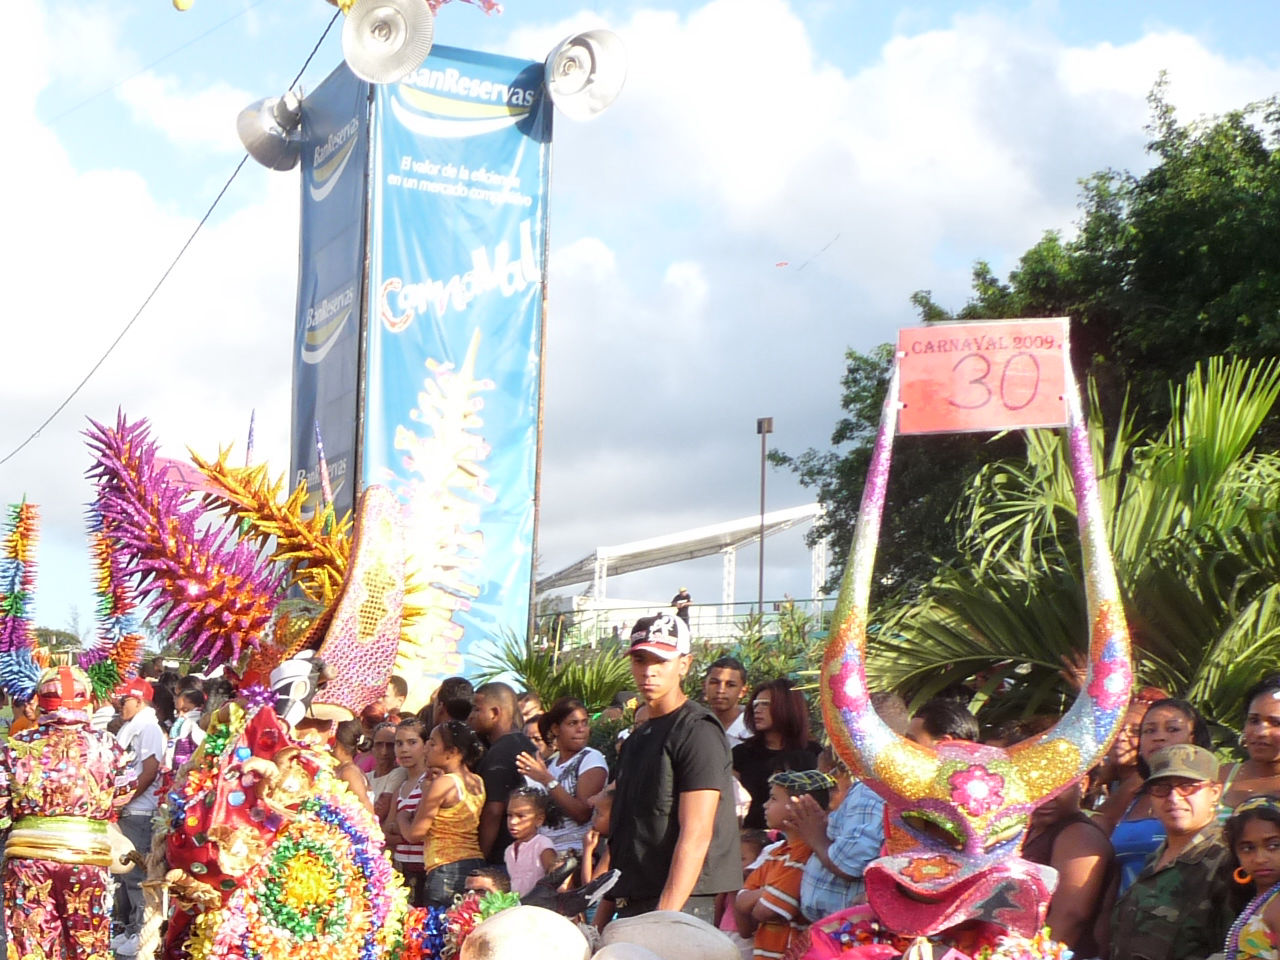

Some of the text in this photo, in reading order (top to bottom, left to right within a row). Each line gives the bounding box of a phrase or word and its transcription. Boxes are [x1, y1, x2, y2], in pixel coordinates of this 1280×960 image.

[400, 155, 412, 171] El
[412, 159, 441, 177] valor
[441, 162, 458, 179] de
[458, 164, 470, 181] la
[387, 173, 402, 187] en
[402, 177, 418, 190] un
[418, 179, 469, 198] mercado
[911, 335, 1055, 355] CARNAVAL 2009
[948, 352, 1040, 411] 30
